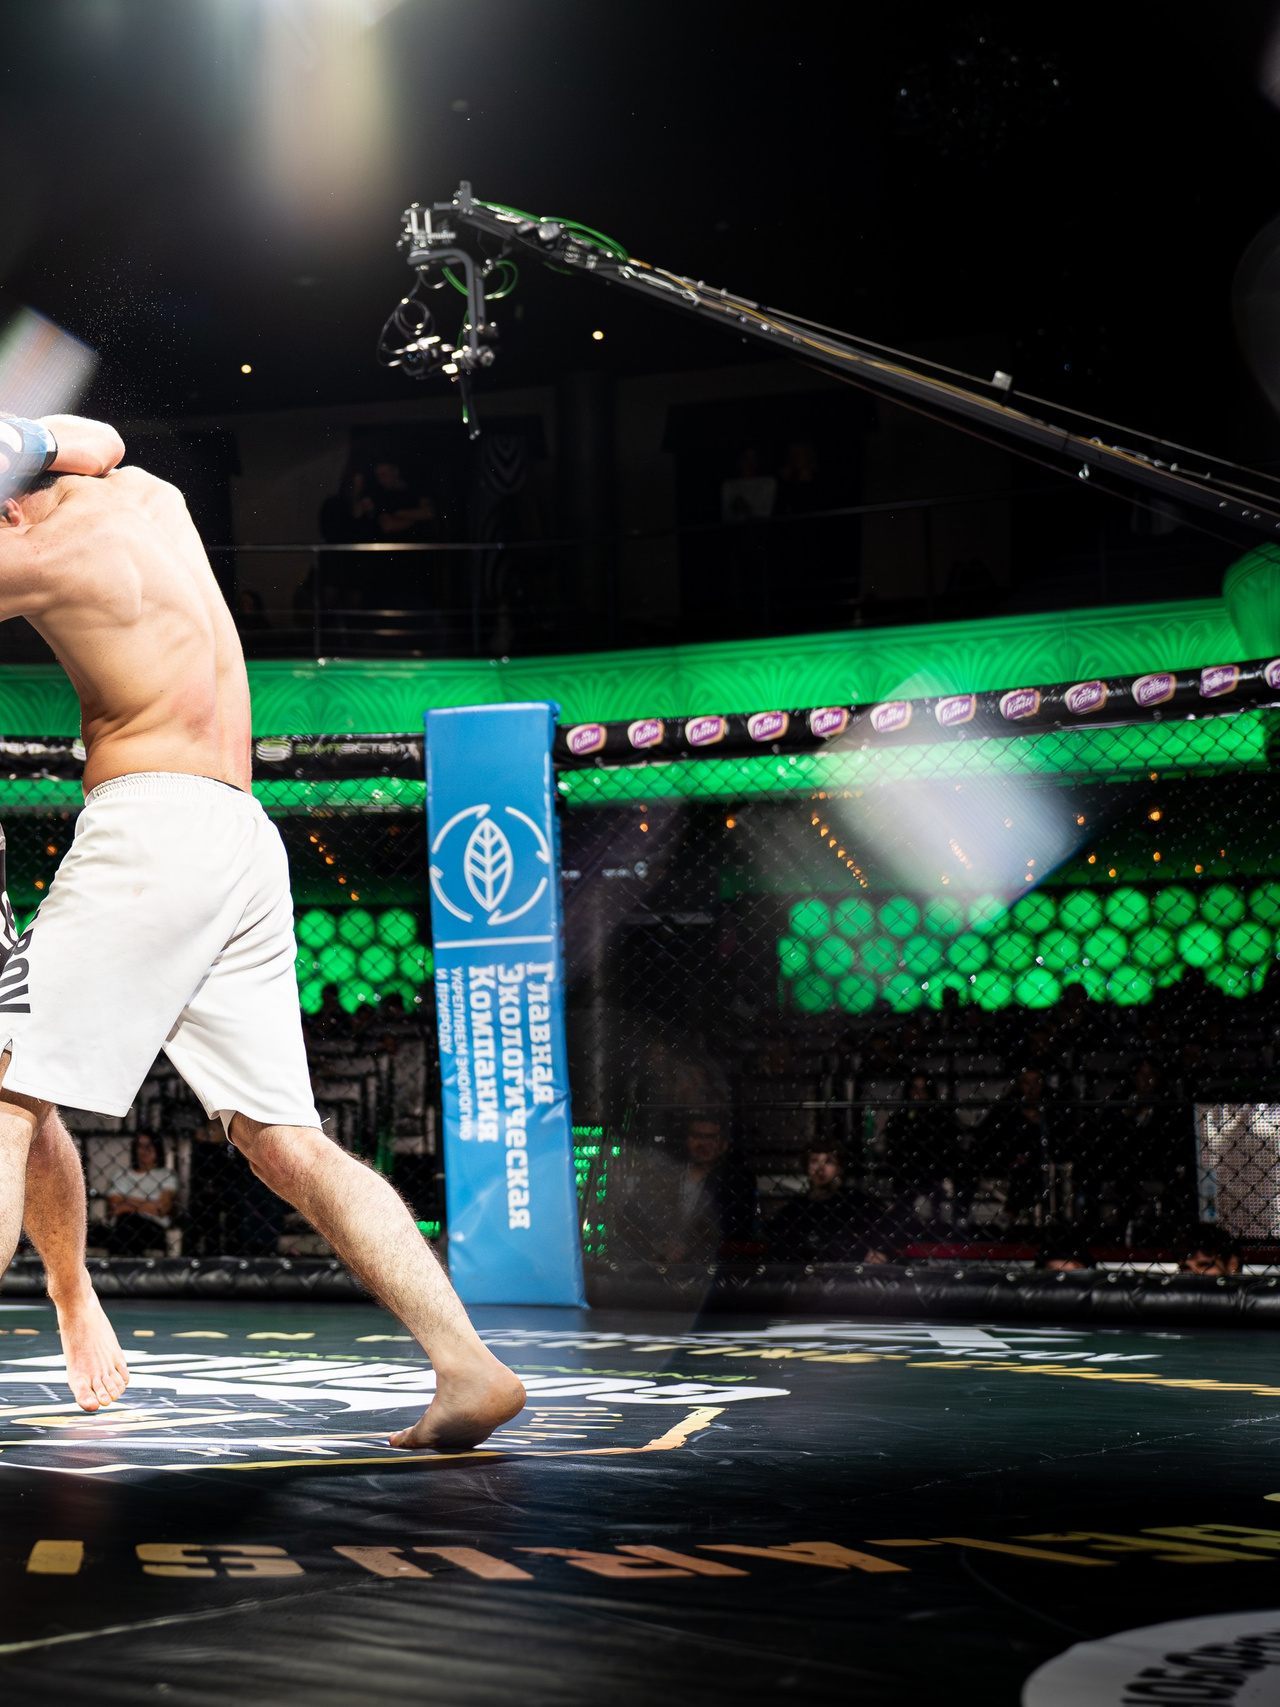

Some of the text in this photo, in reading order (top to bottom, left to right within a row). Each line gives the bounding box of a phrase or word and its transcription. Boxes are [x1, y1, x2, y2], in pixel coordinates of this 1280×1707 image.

[437, 982, 454, 1055] ПРИРОДУ
[451, 966, 473, 1142] УКРЕПЛЯЕМ ЭКОЛОГИЮ
[468, 964, 500, 1143] Компания
[497, 963, 531, 1230] Экологическая
[526, 960, 556, 1105] Главная
